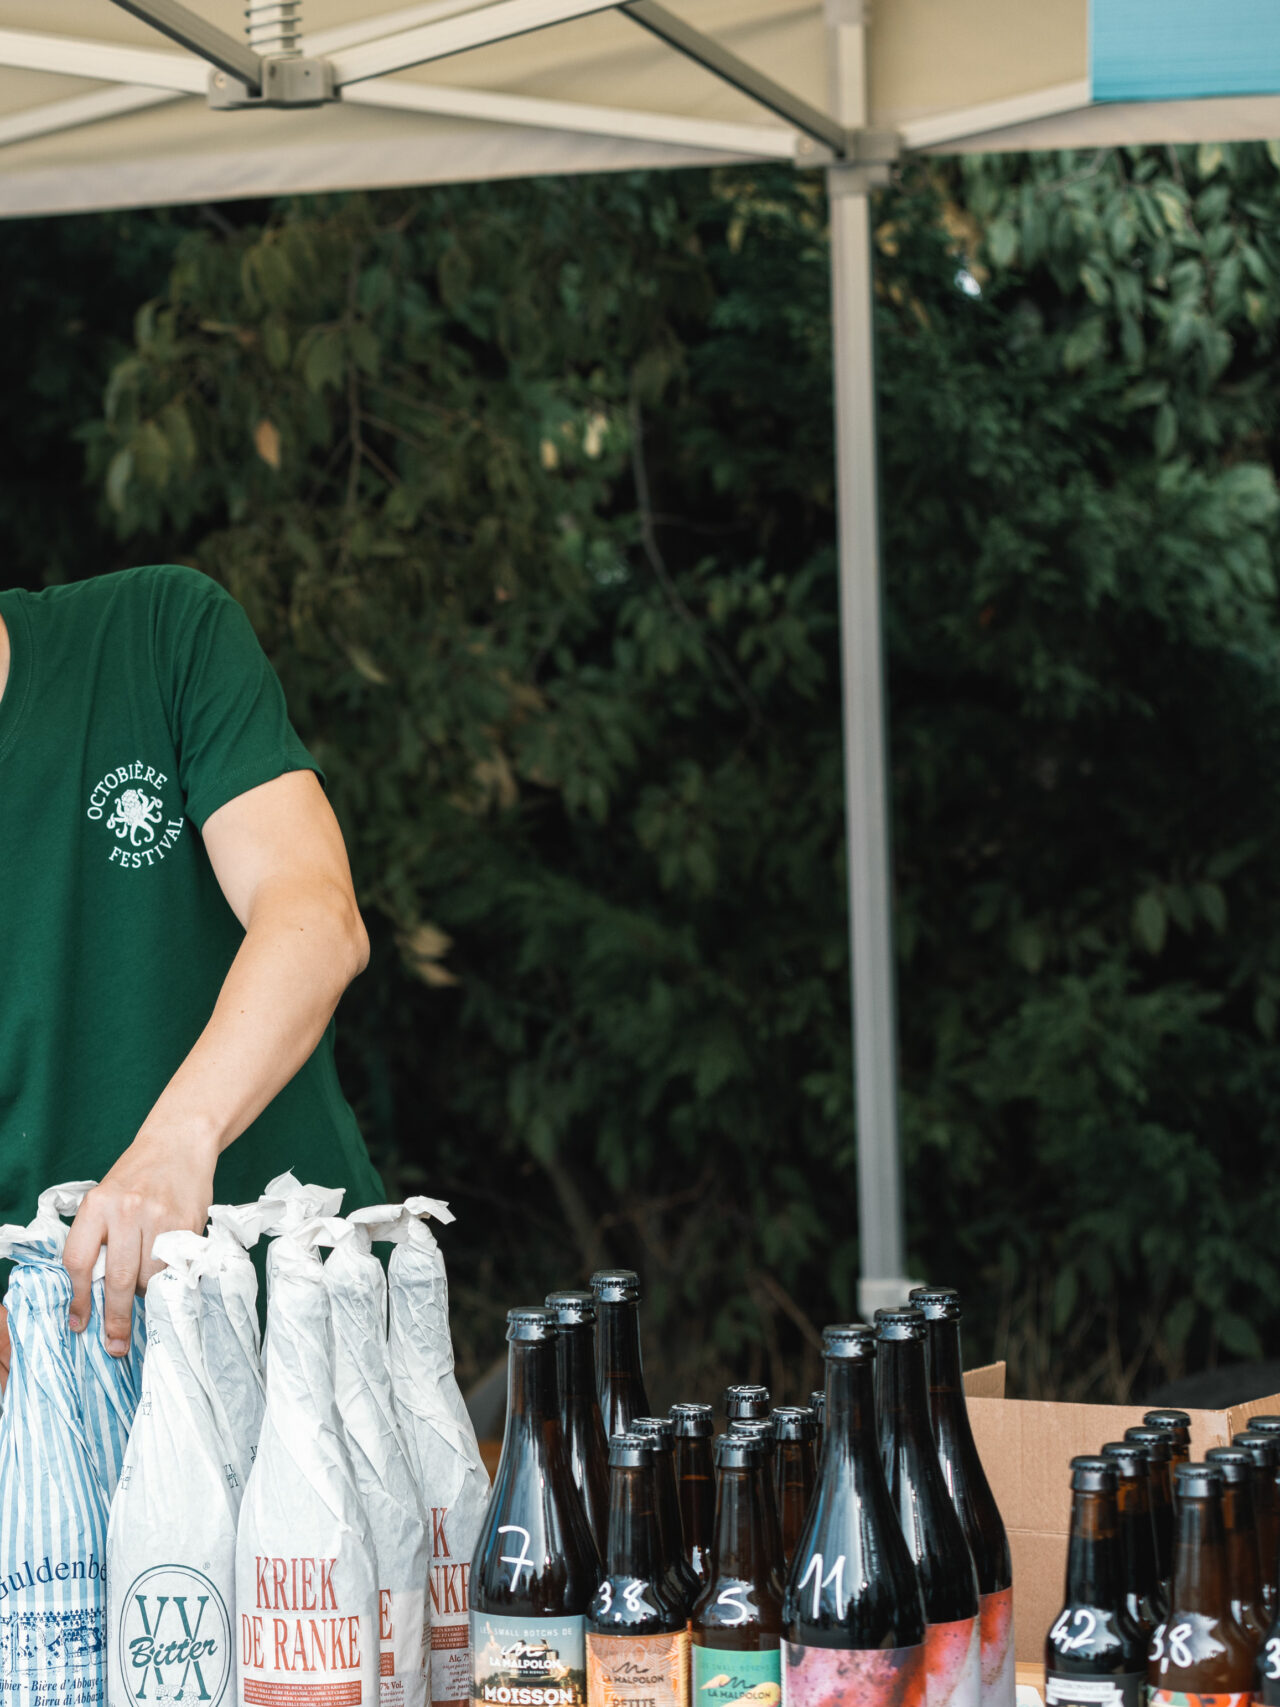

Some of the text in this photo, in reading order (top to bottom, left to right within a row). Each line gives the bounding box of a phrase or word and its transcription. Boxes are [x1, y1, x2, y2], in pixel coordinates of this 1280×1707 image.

[87, 760, 168, 820] OCTOBIÈRE
[108, 817, 184, 869] FESTIVAL
[498, 1525, 534, 1592] 7
[255, 1556, 339, 1611] KRIEK
[597, 1578, 649, 1622] 3,8
[798, 1553, 846, 1621] 11
[717, 1587, 747, 1625] 5
[129, 1636, 218, 1668] Bitter
[242, 1613, 361, 1673] DE RANKE
[1050, 1608, 1097, 1653] 4,2
[1148, 1623, 1193, 1674] 3,8
[489, 1656, 561, 1670] LA MALPOLON
[614, 1674, 663, 1685] MALPOLON
[31, 1680, 57, 1691] Bière
[63, 1694, 73, 1703] di
[484, 1684, 573, 1705] MOISSON
[708, 1689, 771, 1699] LA MALPOLON
